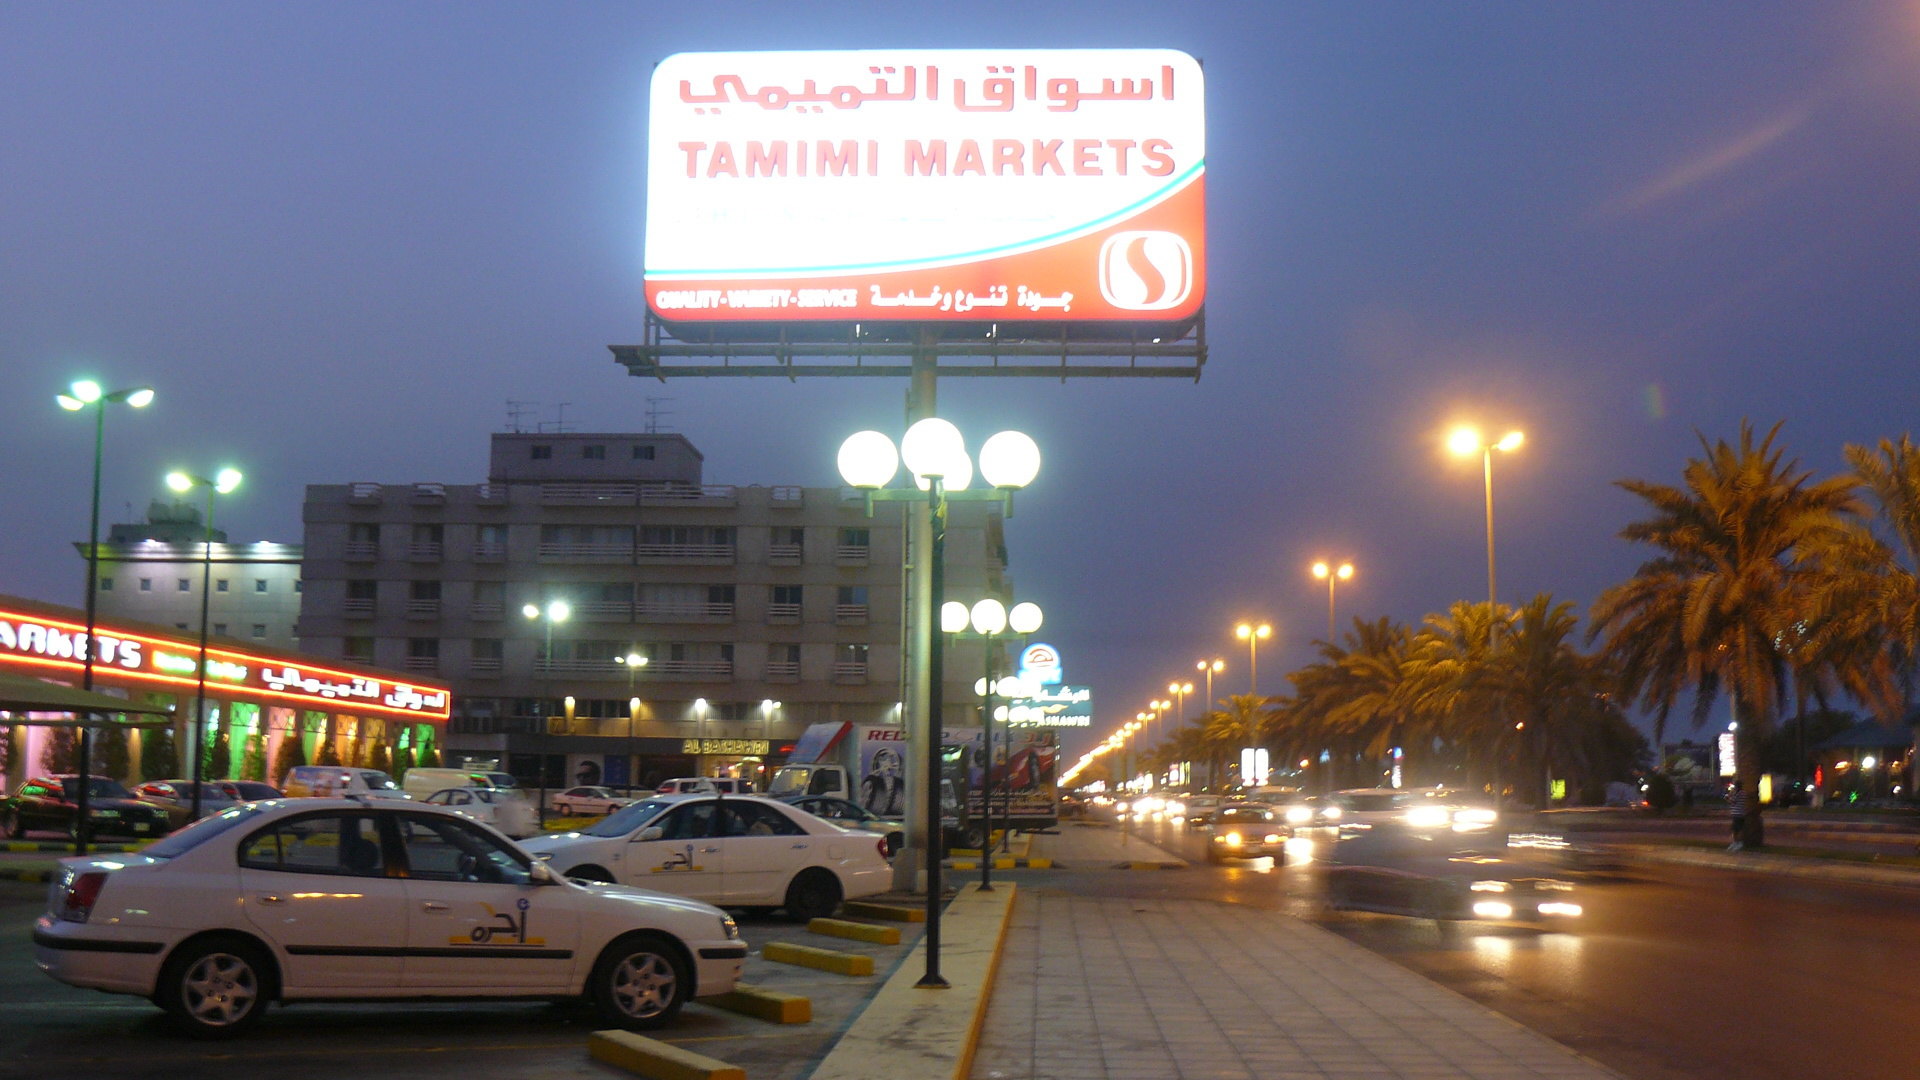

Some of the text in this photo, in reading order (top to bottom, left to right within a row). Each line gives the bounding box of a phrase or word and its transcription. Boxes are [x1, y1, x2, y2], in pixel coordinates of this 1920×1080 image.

[679, 65, 938, 114] التميمي
[679, 139, 1176, 178] TAMIMI MARKETS
